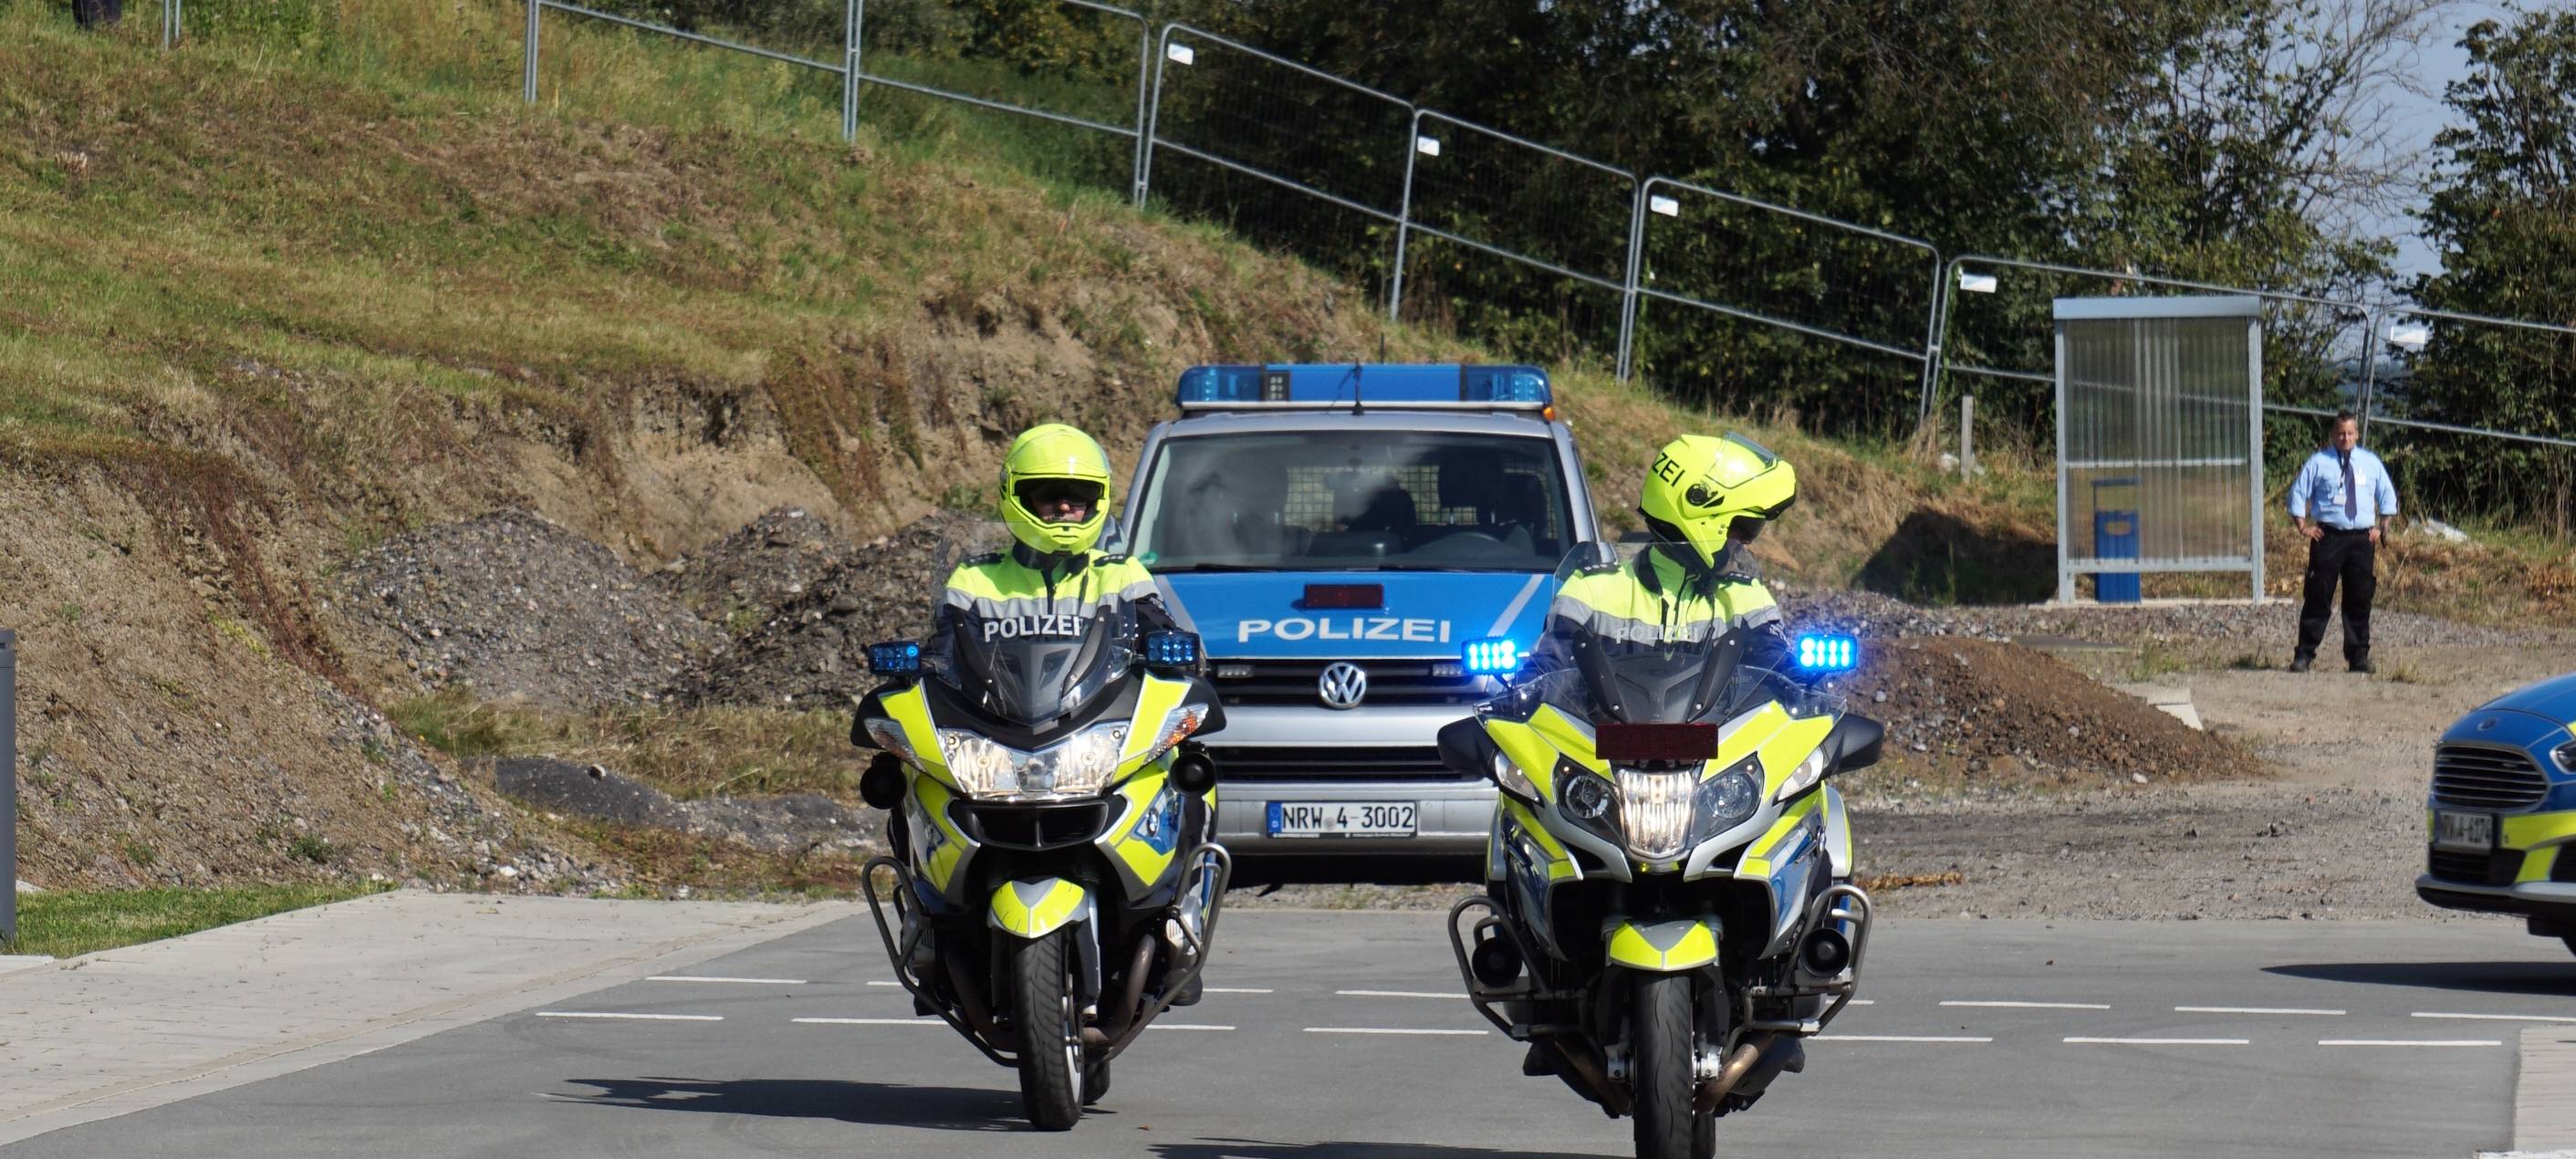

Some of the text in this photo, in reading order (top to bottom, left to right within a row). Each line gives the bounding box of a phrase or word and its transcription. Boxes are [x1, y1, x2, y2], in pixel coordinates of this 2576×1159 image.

[984, 614, 1081, 642] POLIZEI
[1237, 618, 1451, 643] POLIZEI
[1282, 807, 1413, 830] NRW 4-3002
